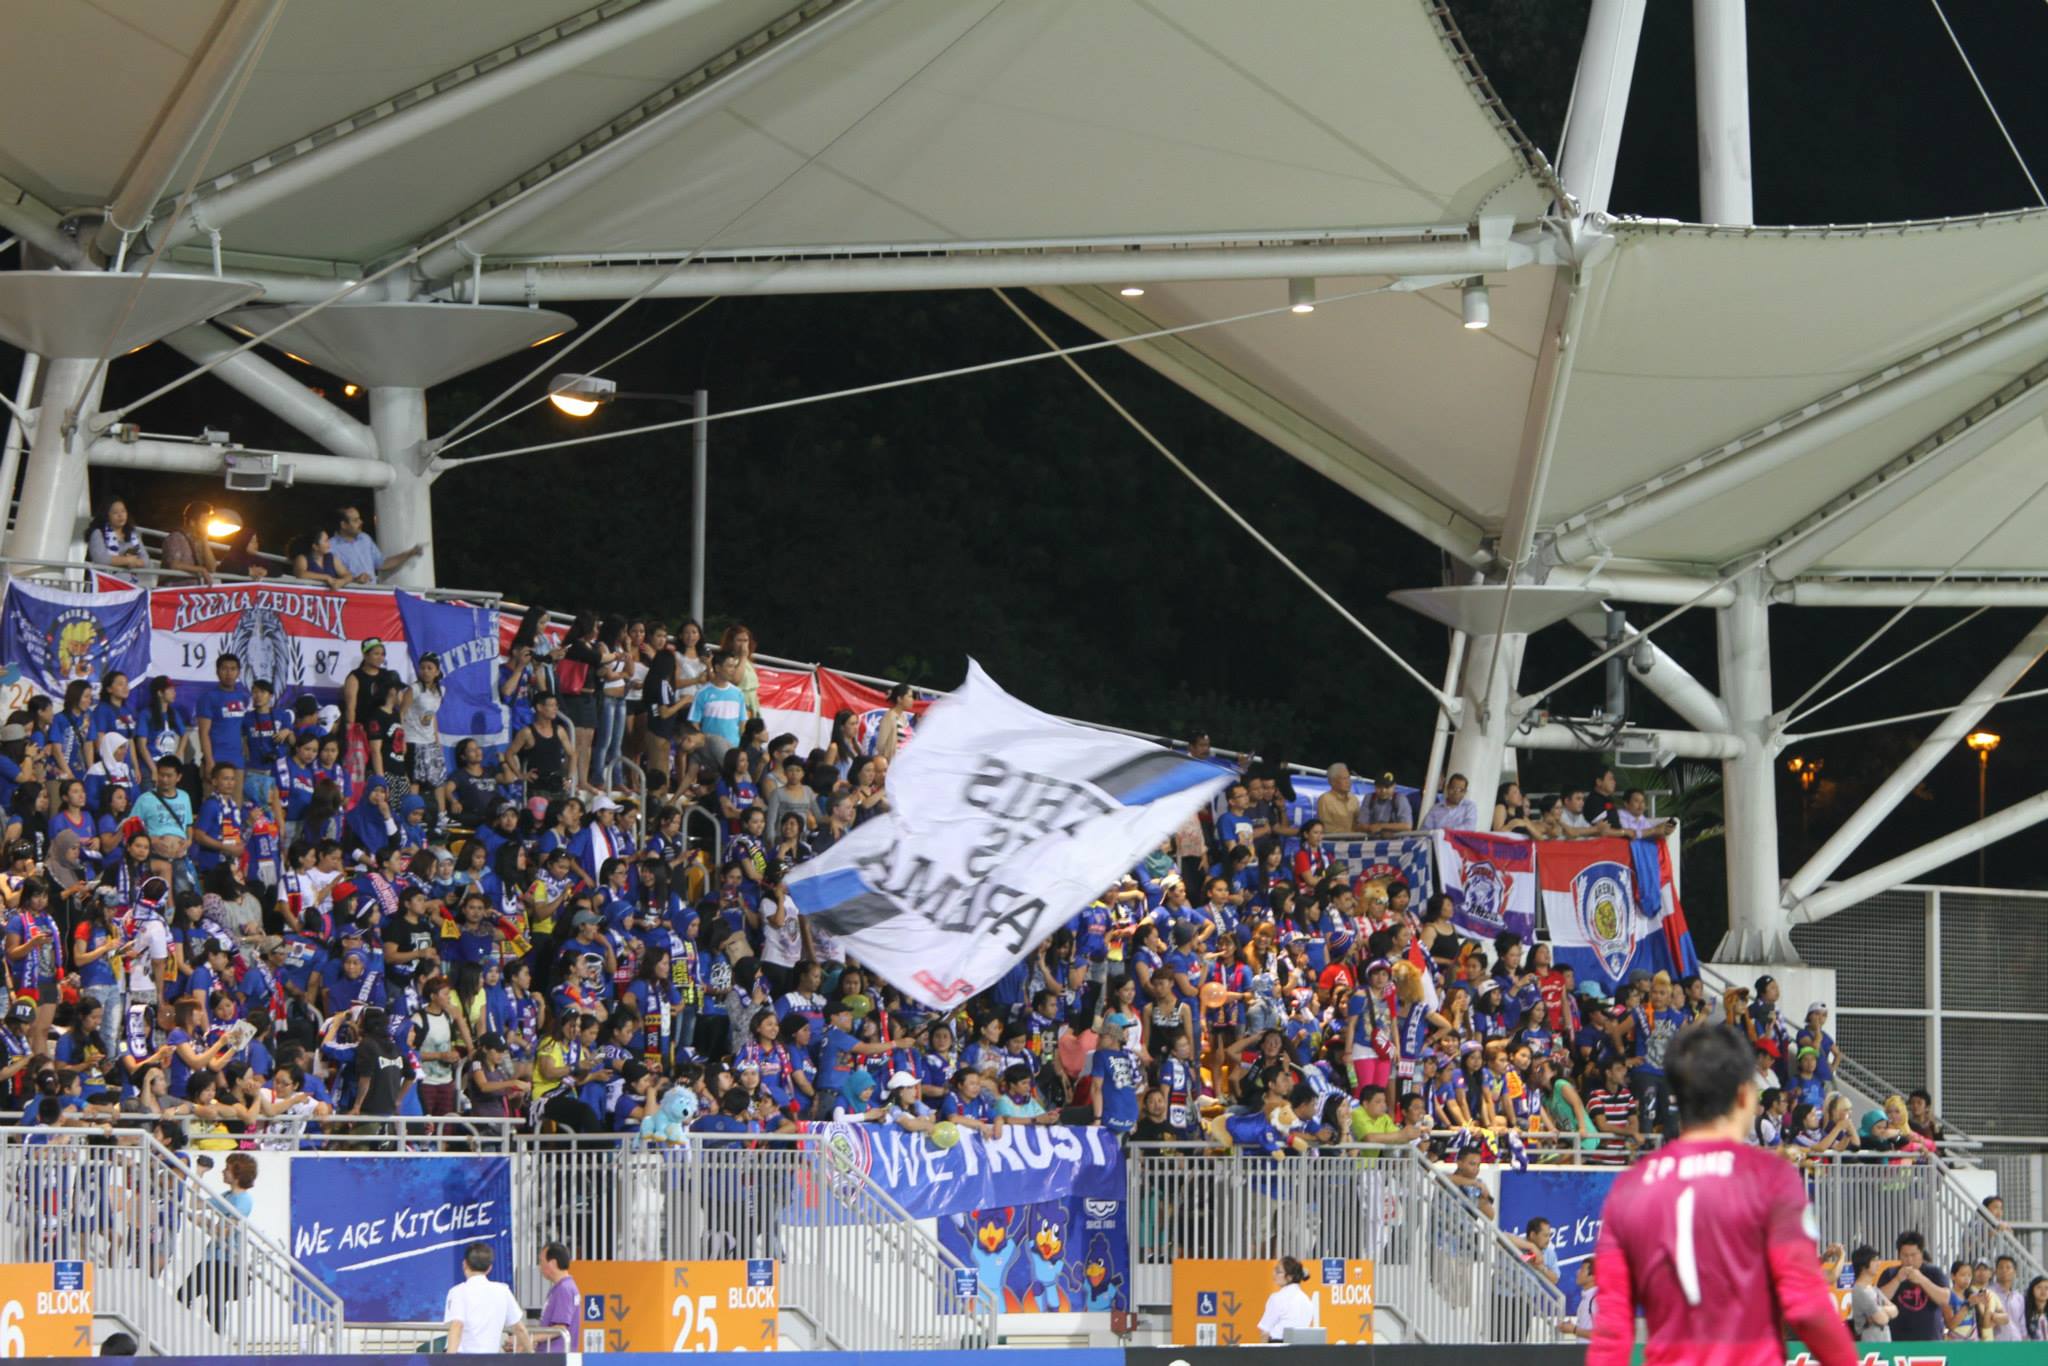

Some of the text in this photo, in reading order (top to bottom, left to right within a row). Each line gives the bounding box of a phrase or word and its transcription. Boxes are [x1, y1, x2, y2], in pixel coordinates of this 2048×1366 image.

[172, 591, 253, 633] AREMA
[256, 590, 347, 641] ZEDENX
[181, 642, 207, 669] 19
[315, 649, 339, 675] 87
[872, 1124, 1106, 1188] WE TRUST
[294, 1221, 335, 1259] WE
[338, 1218, 387, 1250] ARE
[1676, 1186, 1702, 1306] 1
[37, 1291, 91, 1315] BLOCK
[728, 1286, 775, 1309] BLOCK
[1331, 1284, 1372, 1305] BLOCK
[672, 1295, 718, 1352] 25
